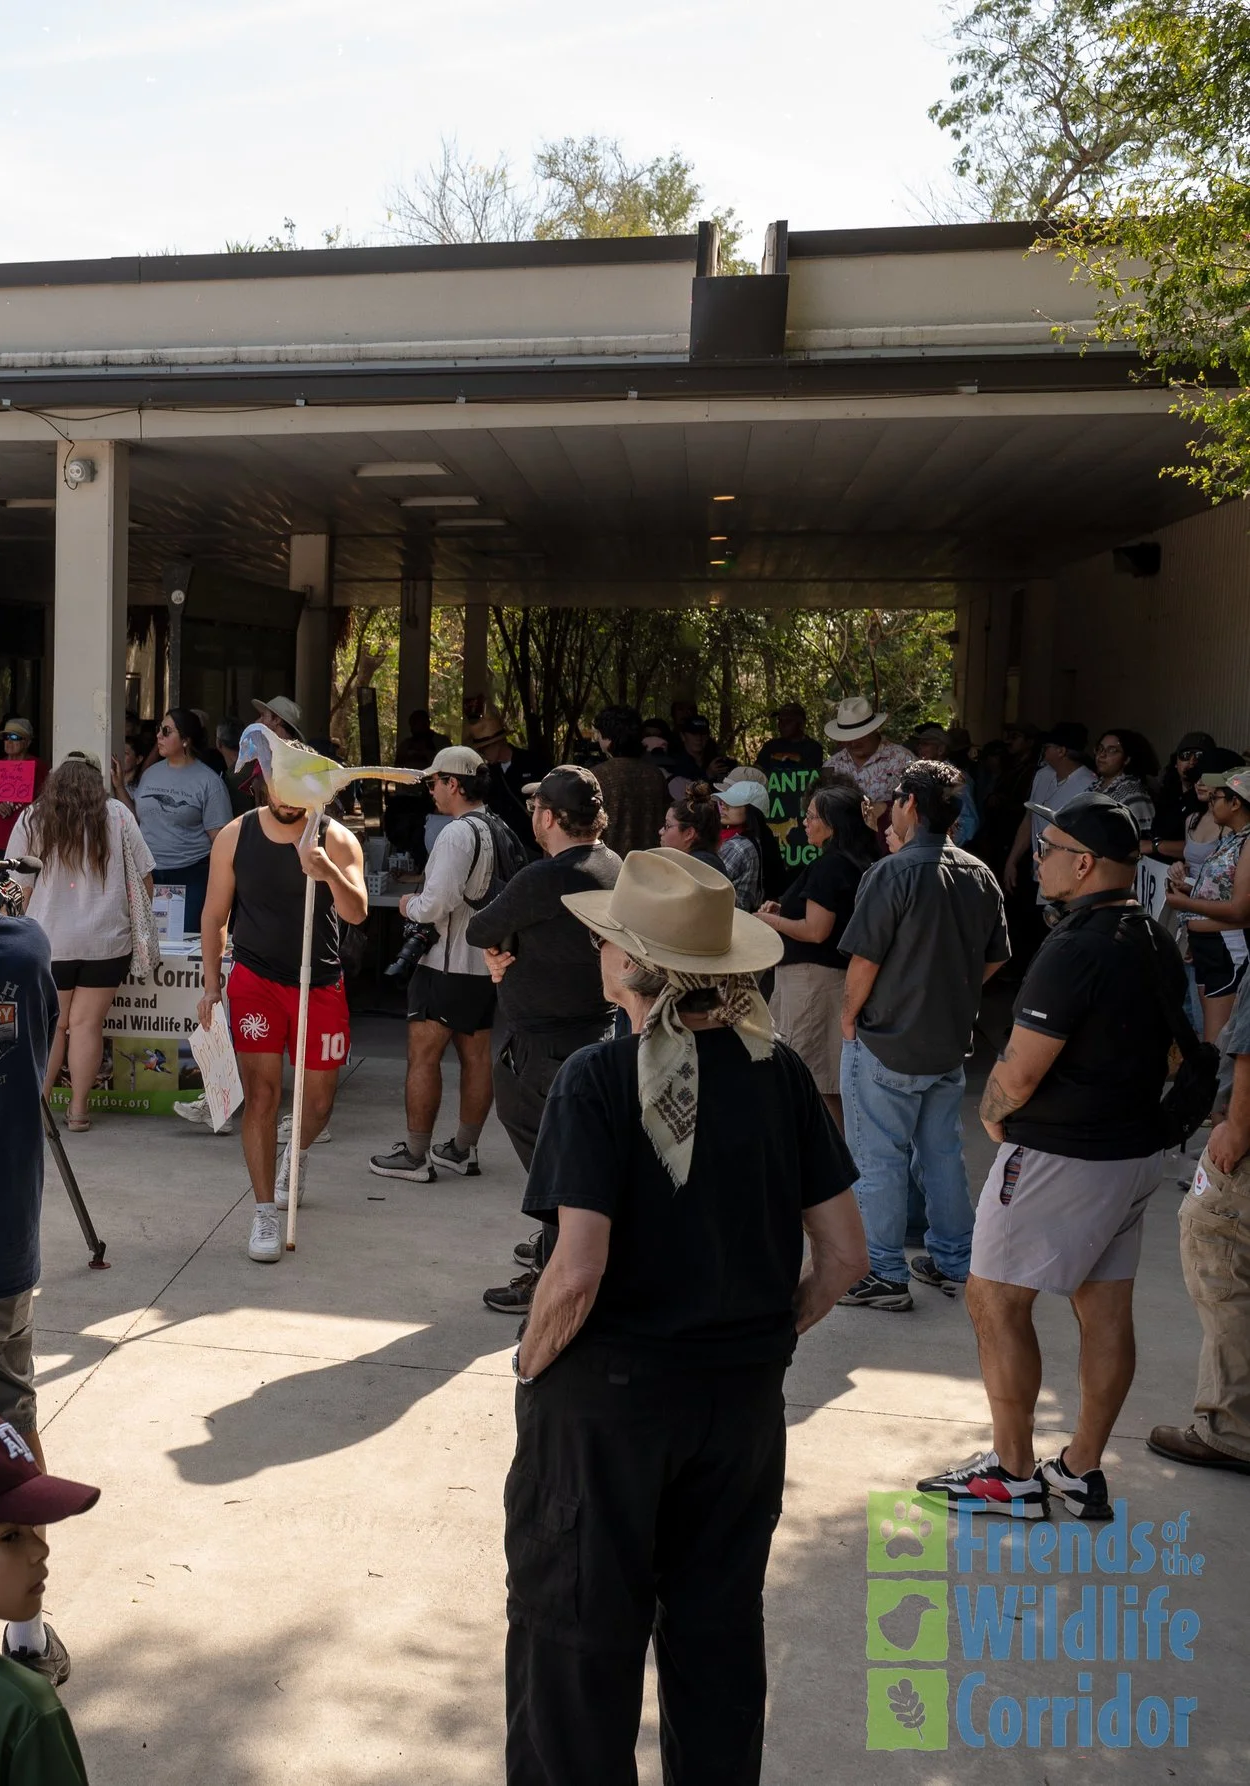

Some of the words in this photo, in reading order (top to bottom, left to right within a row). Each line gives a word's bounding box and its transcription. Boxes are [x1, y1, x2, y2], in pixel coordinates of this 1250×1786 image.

[134, 993, 157, 1009] and
[102, 1014, 127, 1030] onal
[130, 1014, 180, 1032] Wildlife
[321, 1032, 345, 1061] 10
